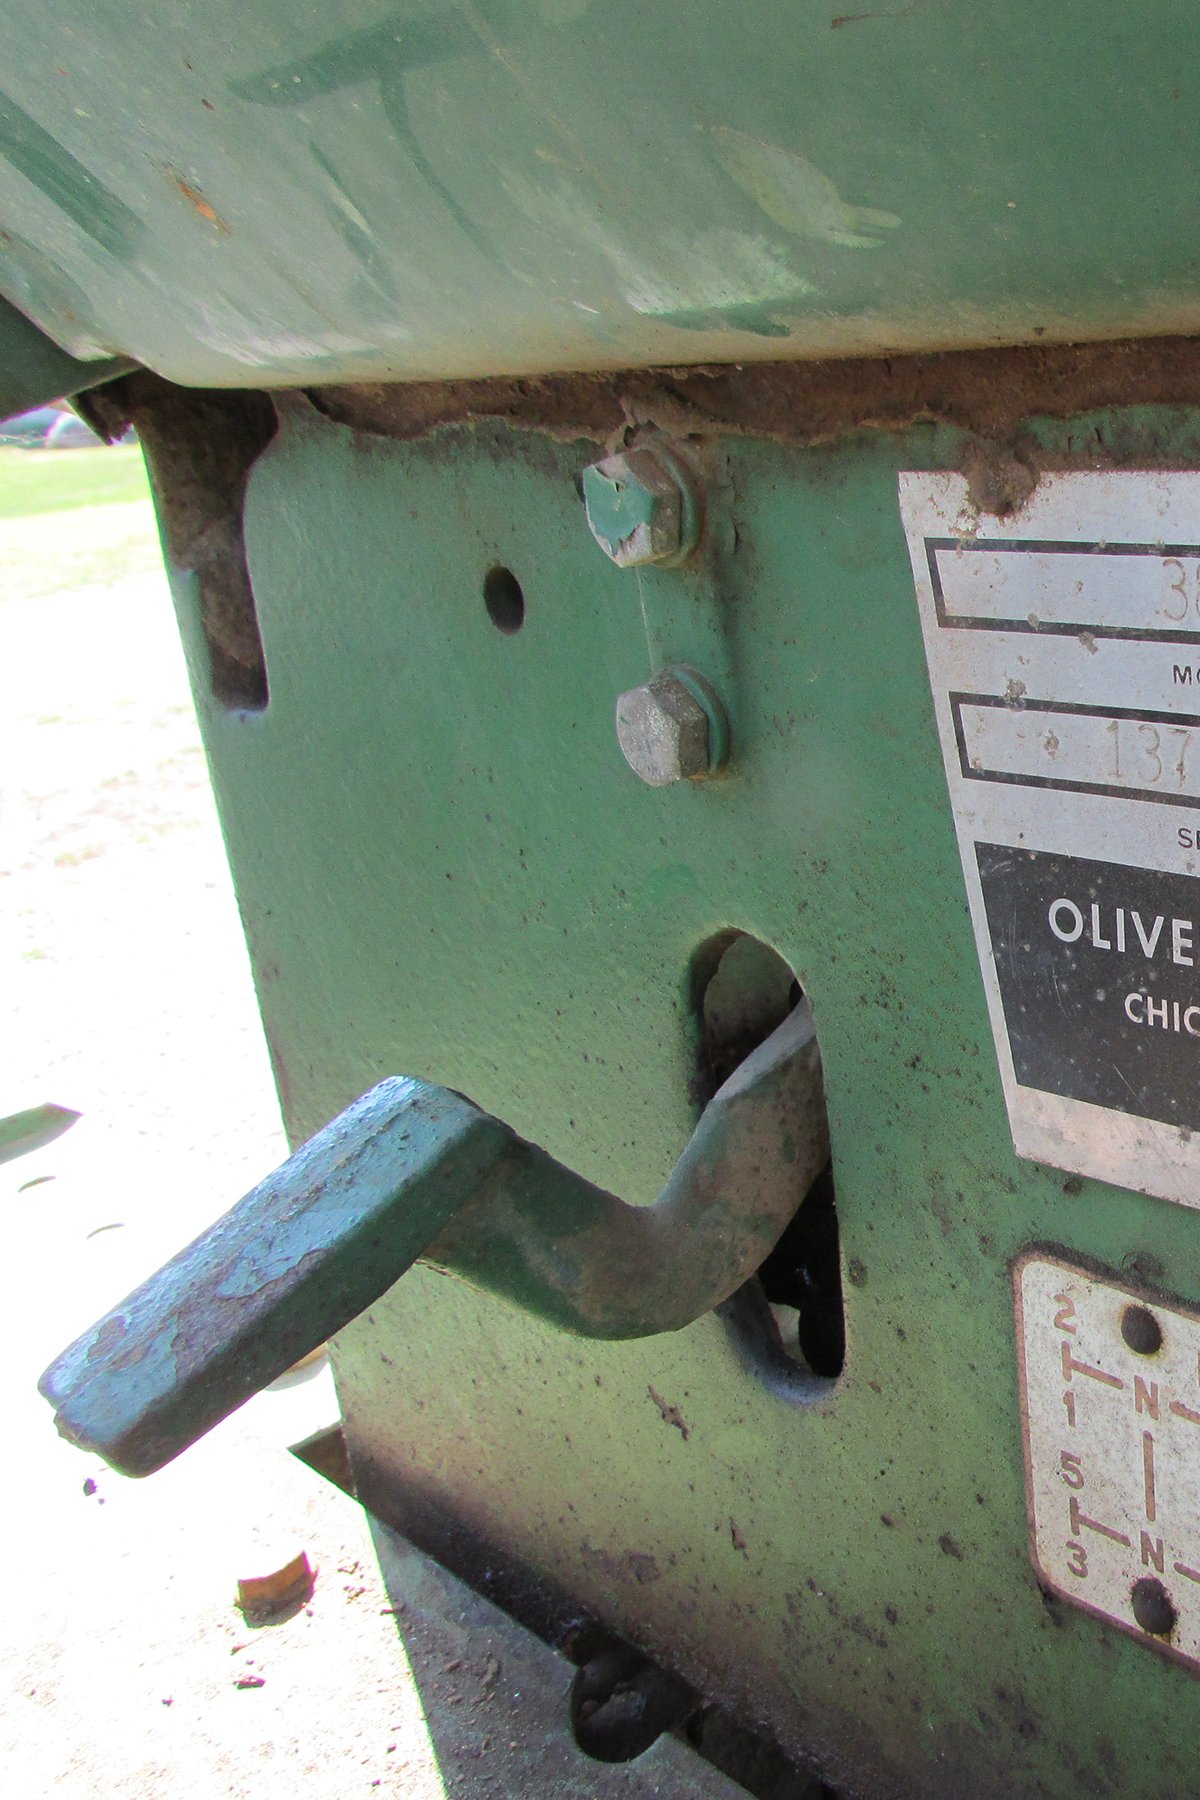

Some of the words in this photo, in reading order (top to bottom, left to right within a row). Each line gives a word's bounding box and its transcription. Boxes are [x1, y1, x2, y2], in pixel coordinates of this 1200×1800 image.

[1105, 719, 1193, 788] 137
[1053, 1293, 1077, 1336] 2
[1062, 1390, 1076, 1428] 1
[1133, 1374, 1159, 1421] N
[1060, 1449, 1085, 1490] 5
[1065, 1540, 1089, 1579] 3
[1140, 1530, 1165, 1574] N
